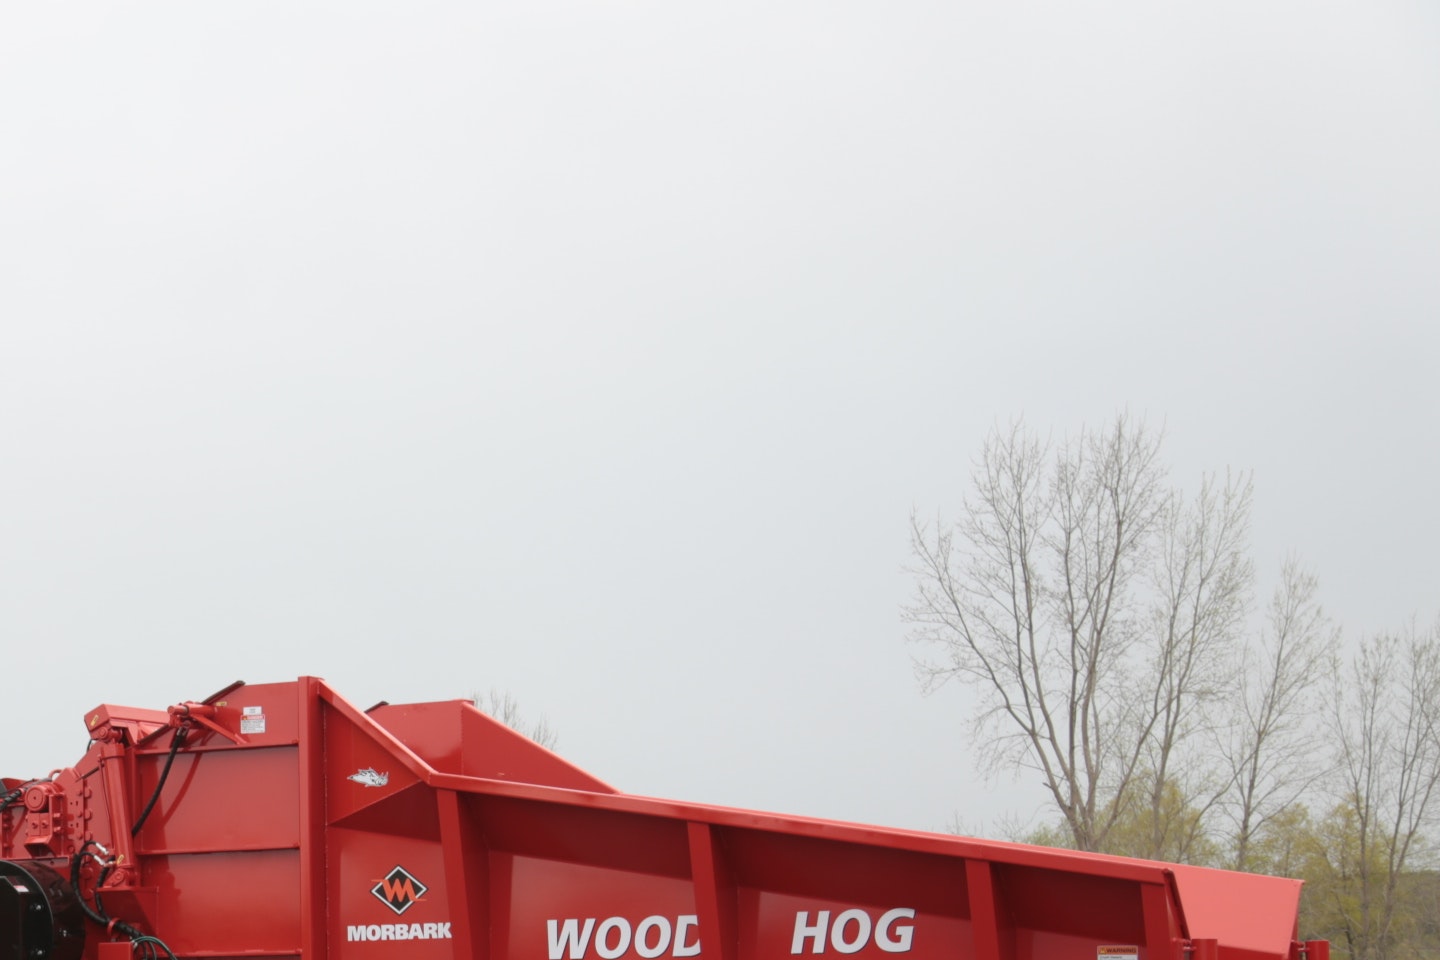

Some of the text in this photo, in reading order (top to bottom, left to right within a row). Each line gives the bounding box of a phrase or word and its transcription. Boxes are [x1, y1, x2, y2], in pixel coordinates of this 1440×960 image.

[347, 922, 452, 942] MORBARK
[546, 907, 916, 960] WOOD HOG
